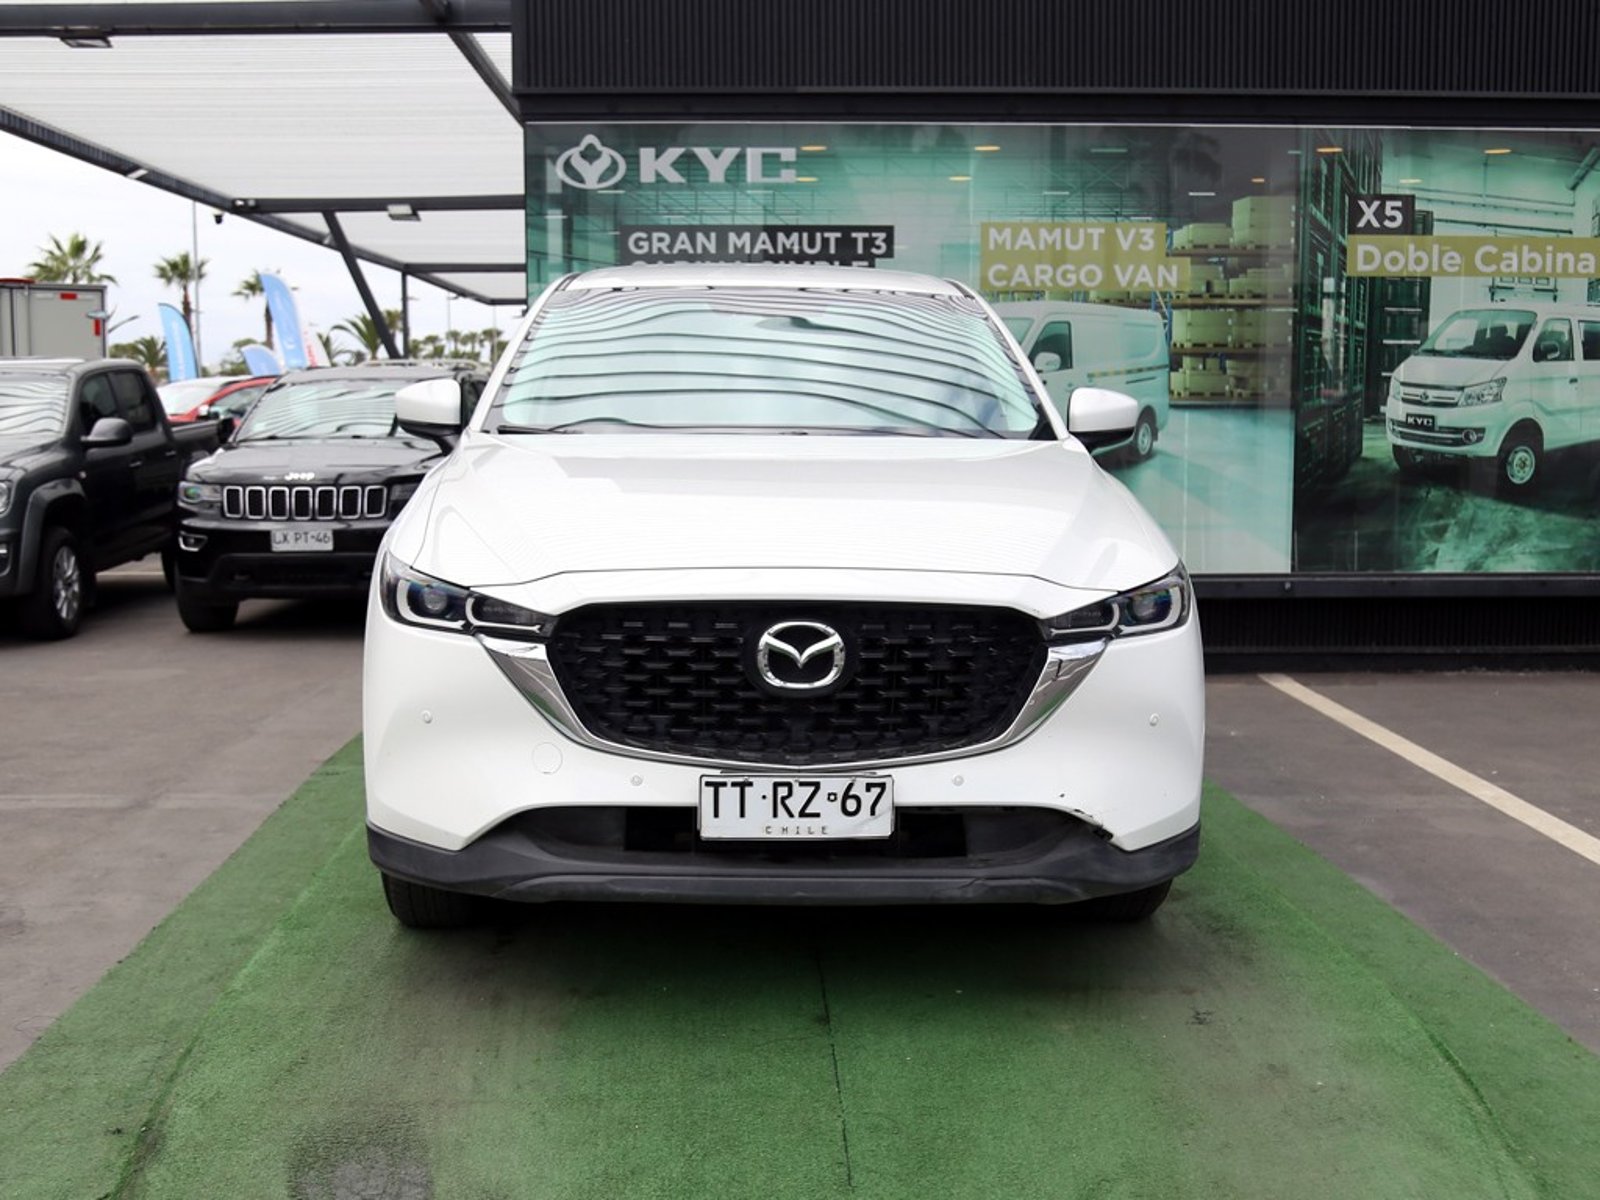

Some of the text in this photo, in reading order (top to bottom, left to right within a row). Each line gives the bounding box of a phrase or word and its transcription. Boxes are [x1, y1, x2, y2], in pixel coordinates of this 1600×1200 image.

[639, 147, 797, 183] KYC
[1356, 200, 1404, 228] X5
[628, 231, 888, 255] GRAN MAMUT T3
[987, 227, 1155, 251] MAMUT V3
[1356, 243, 1597, 275] Doble Cabina
[987, 264, 1178, 288] CARGO VAN
[284, 472, 315, 480] Jeep
[764, 825, 828, 835] CHILE
